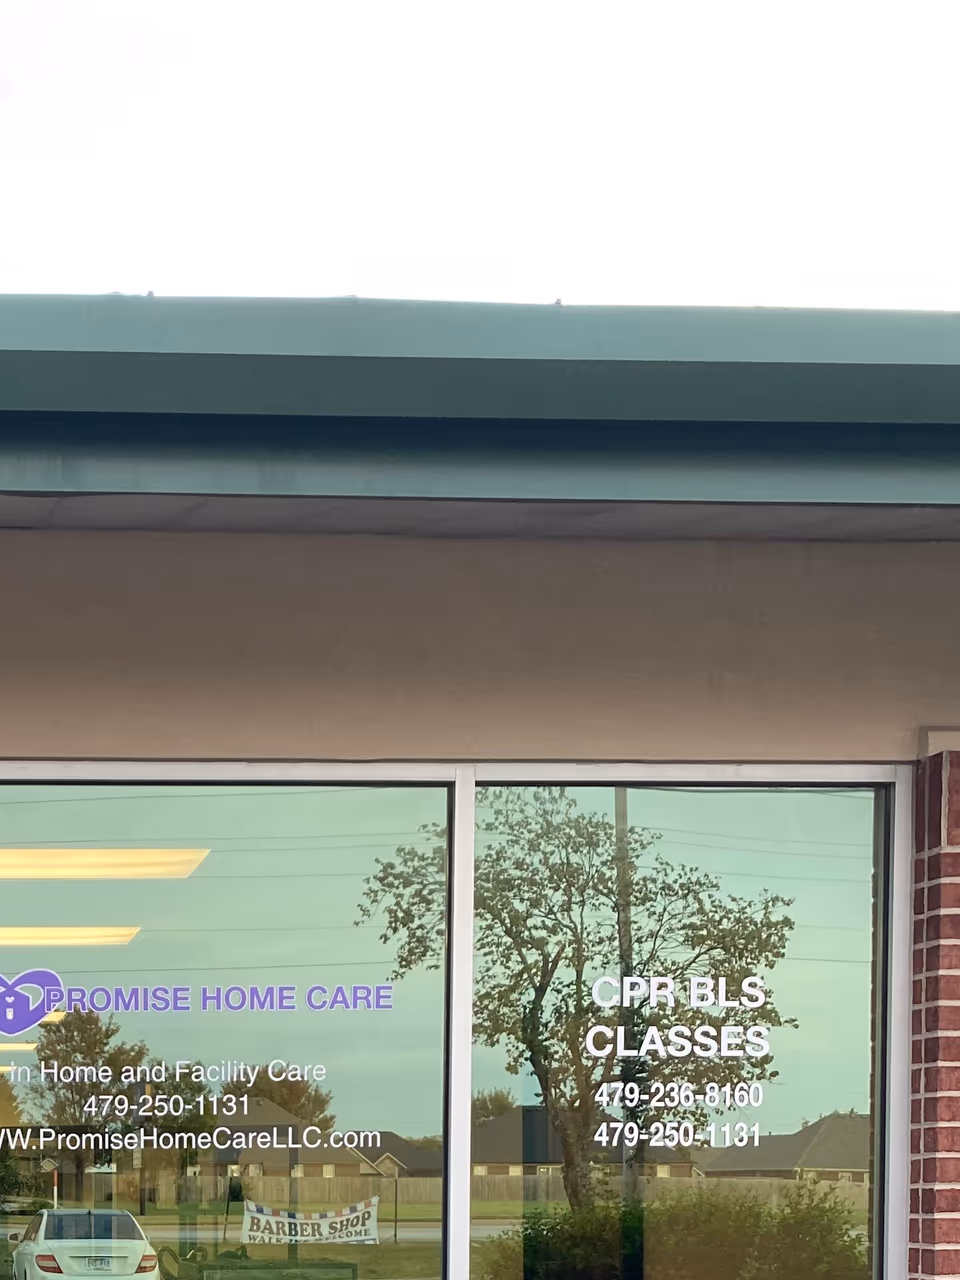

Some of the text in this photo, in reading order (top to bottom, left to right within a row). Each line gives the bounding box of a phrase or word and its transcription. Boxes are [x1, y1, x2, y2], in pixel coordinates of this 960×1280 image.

[44, 984, 394, 1013] PROMISE HOME CARE
[591, 976, 767, 1008] CPR BLS
[585, 1025, 771, 1058] CLASSES
[40, 1060, 113, 1082] Home
[121, 1060, 166, 1082] and
[175, 1060, 259, 1087] Facility
[267, 1059, 327, 1082] Care
[83, 1093, 249, 1117] 479-250-1131
[594, 1082, 764, 1108] 479-236-8160
[593, 1121, 761, 1148] 479-250-1131
[248, 1210, 372, 1238] BARBER SHOP
